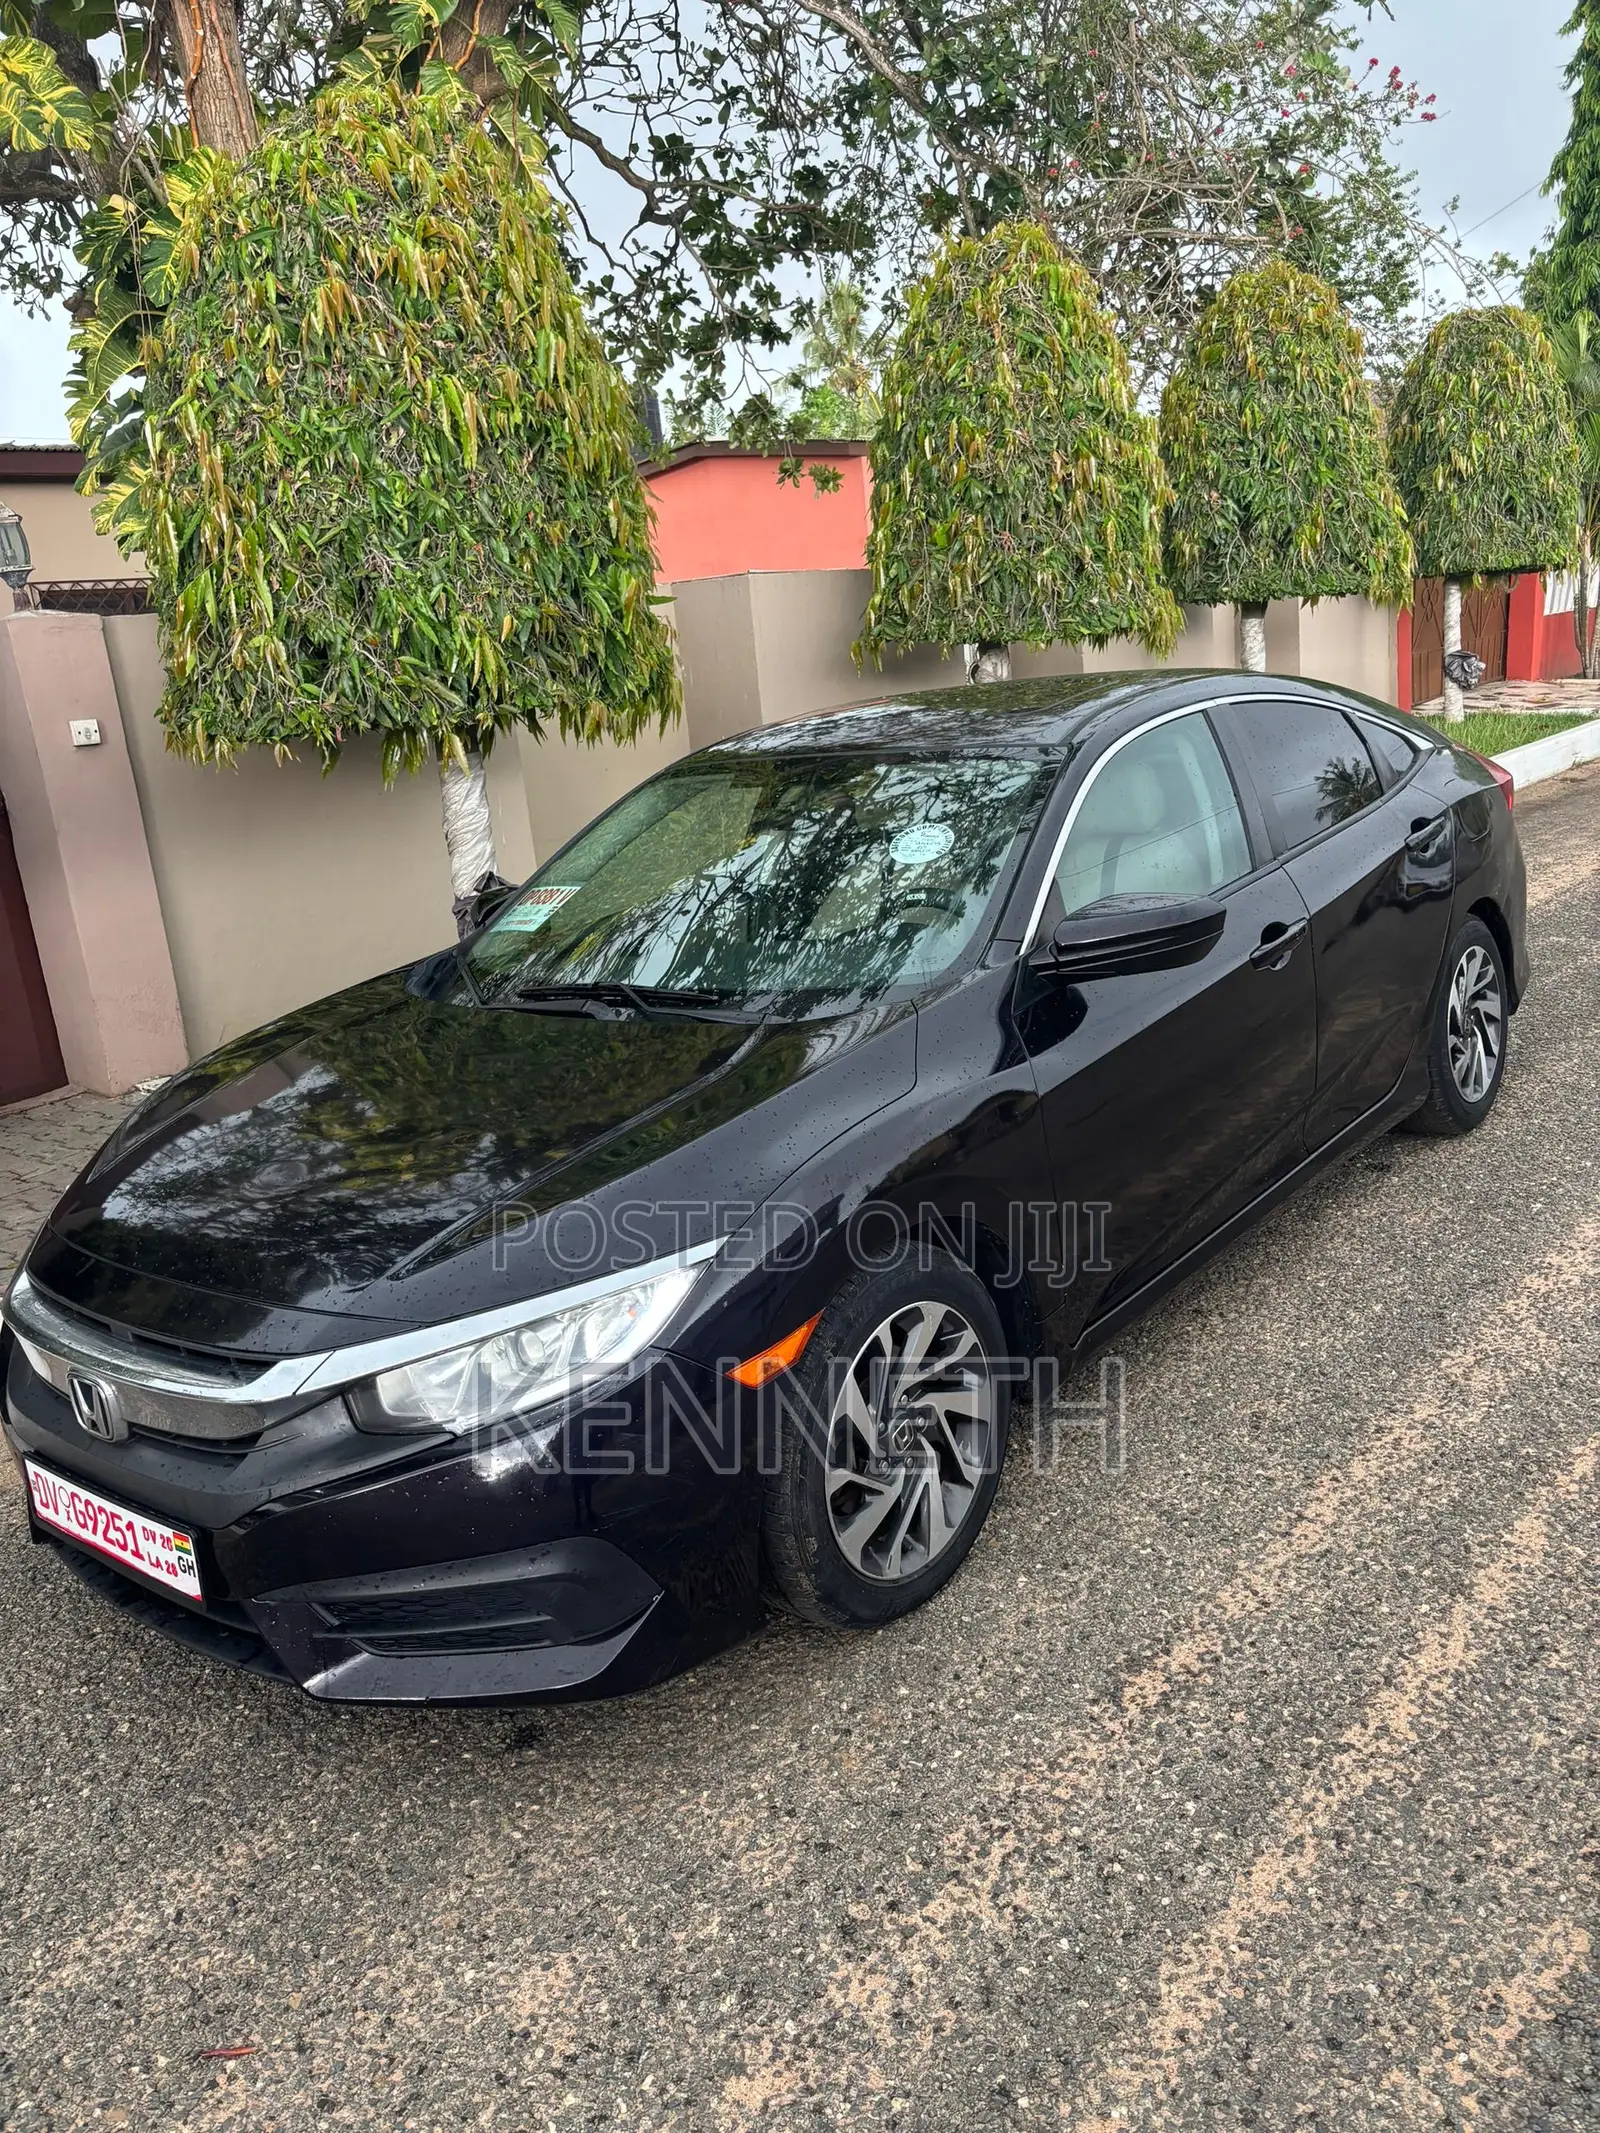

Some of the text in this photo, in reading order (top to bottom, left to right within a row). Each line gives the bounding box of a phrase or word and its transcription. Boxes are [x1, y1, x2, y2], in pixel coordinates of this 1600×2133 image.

[33, 1470, 59, 1516] DV
[70, 1491, 145, 1562] G9251
[141, 1525, 157, 1545] DV
[147, 1551, 164, 1571] LA
[177, 1555, 197, 1578] GH
